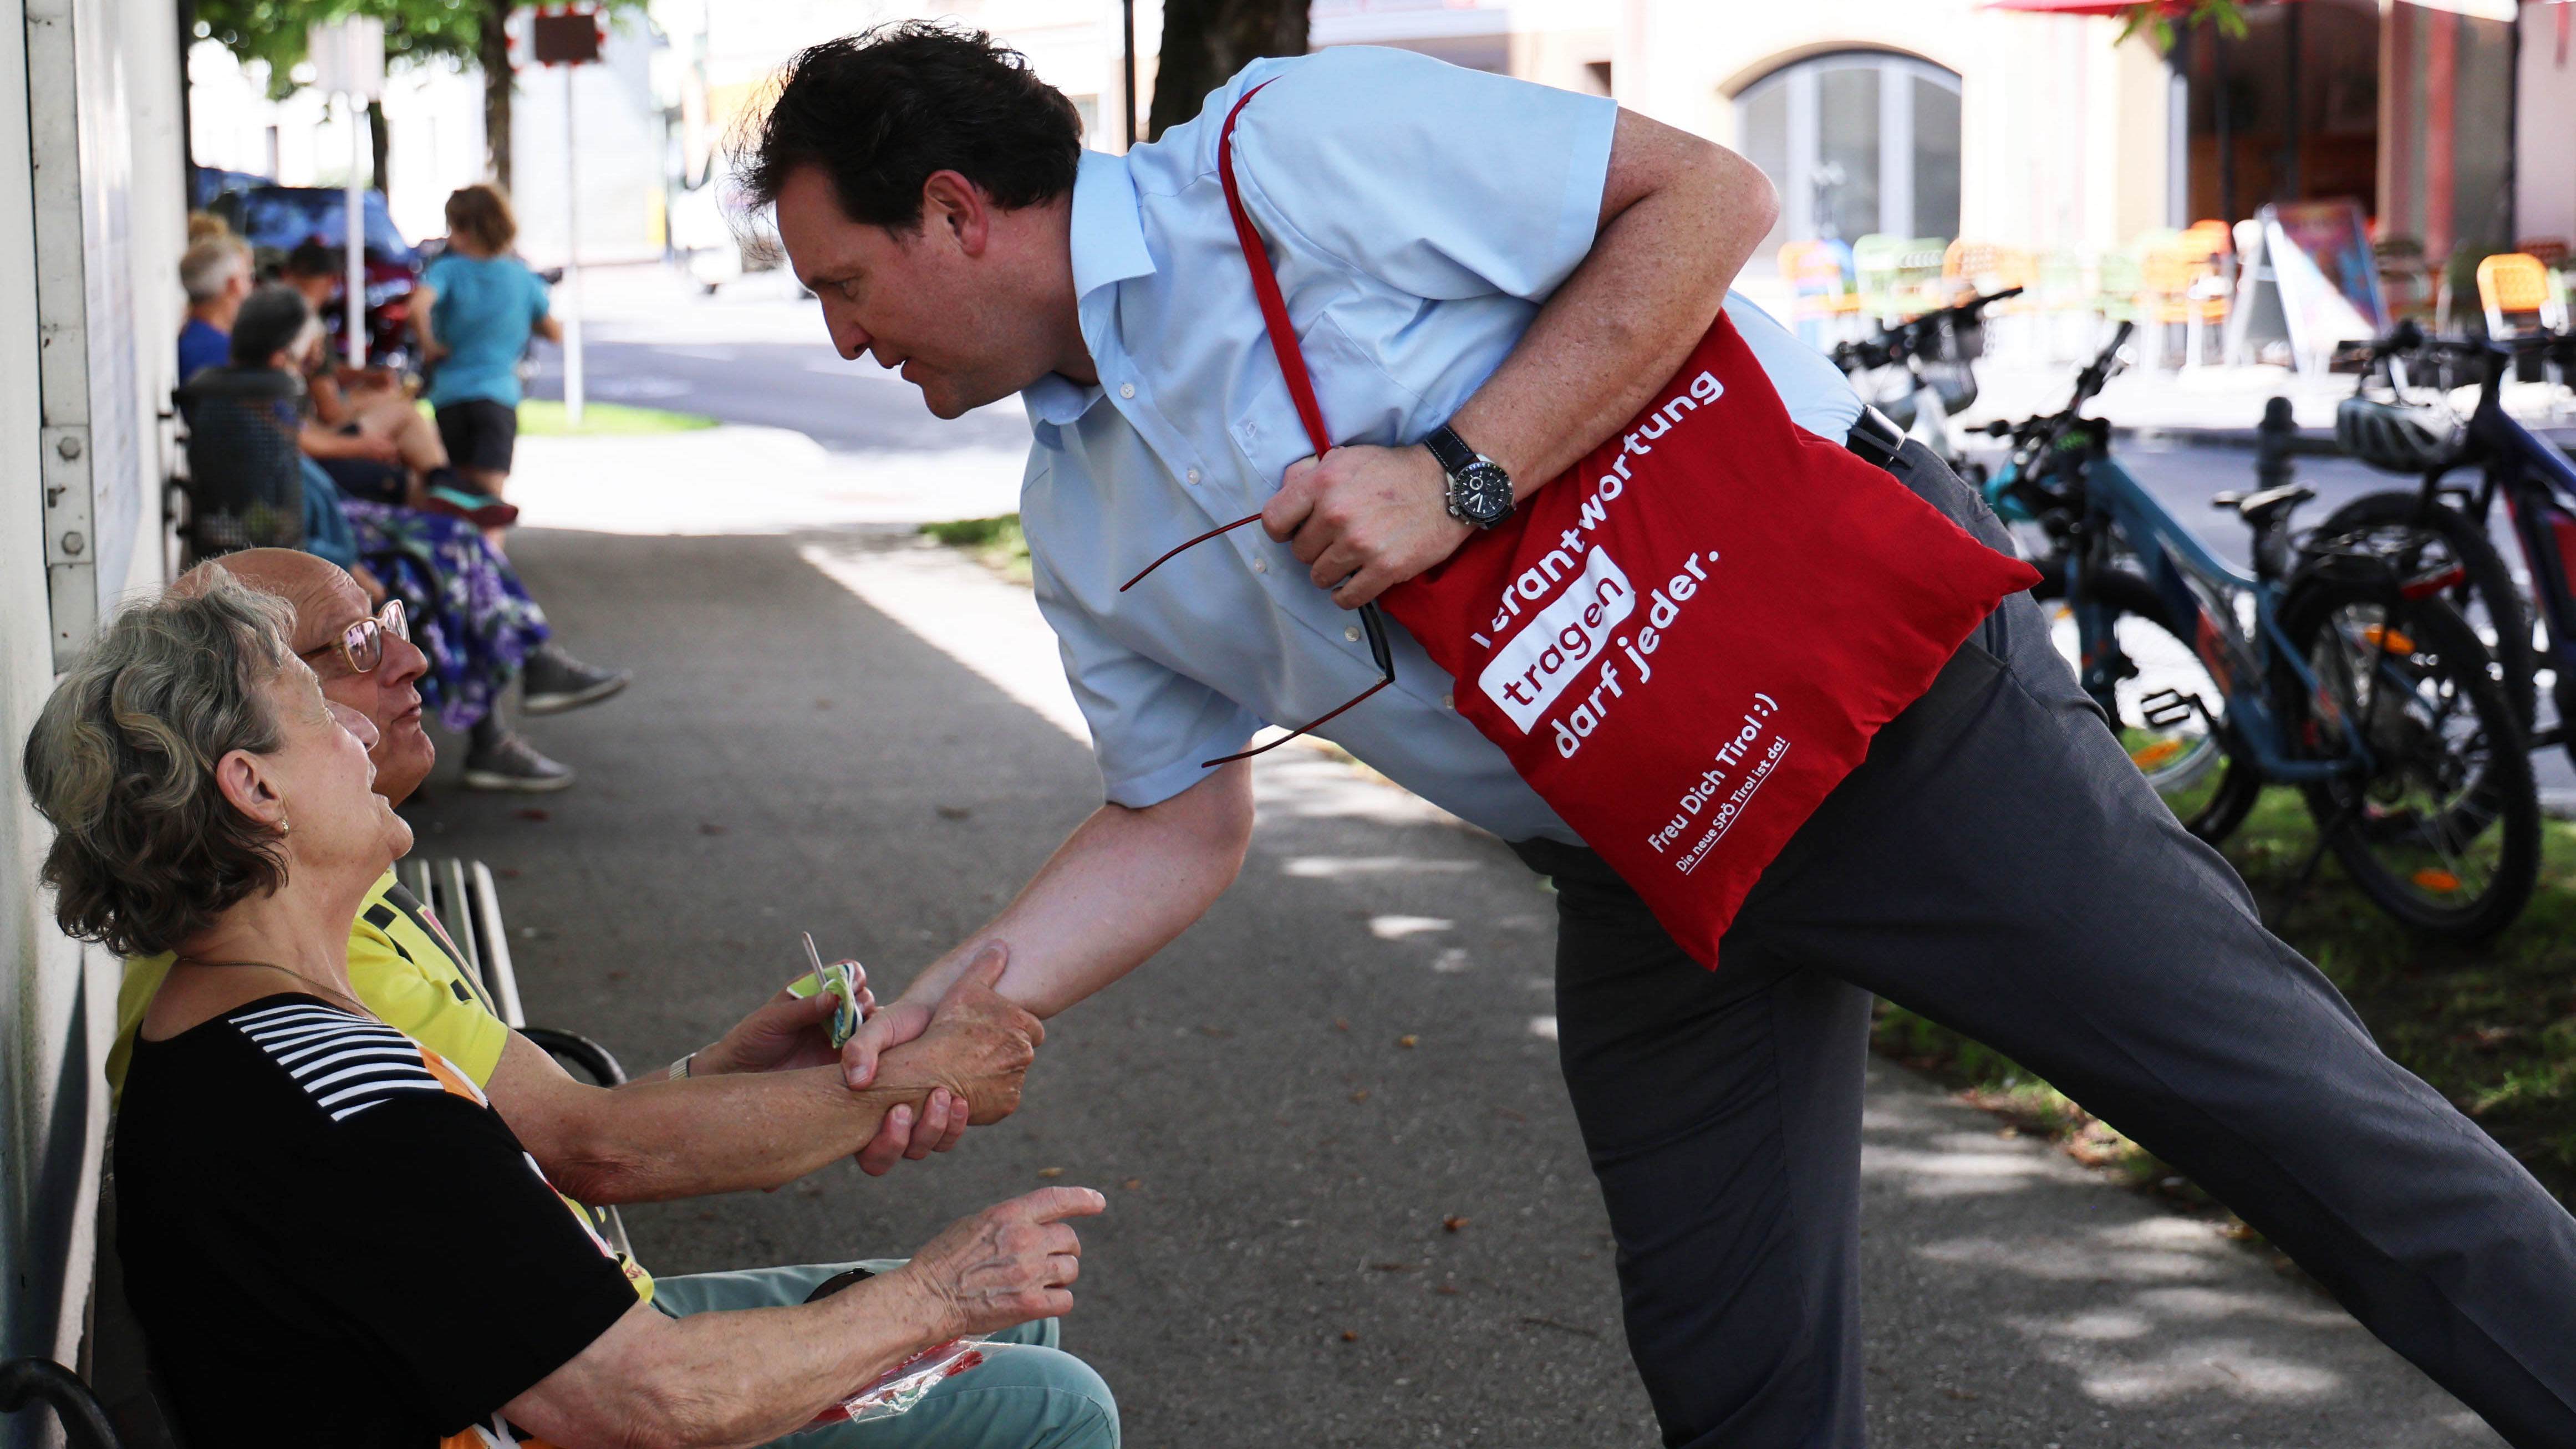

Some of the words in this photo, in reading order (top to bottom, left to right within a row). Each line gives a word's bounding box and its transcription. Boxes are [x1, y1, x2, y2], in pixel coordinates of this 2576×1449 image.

[1503, 577, 1623, 706] tragen
[1551, 659, 1623, 759] darf
[1617, 550, 1719, 684] jeder.
[1647, 813, 1689, 853] Freu
[1679, 769, 1726, 815] Dich
[1715, 714, 1763, 766] Tirol
[1676, 854, 1695, 872] Die
[1692, 829, 1717, 855] neue
[1712, 803, 1735, 830] SPÖ
[1730, 775, 1757, 803] Tirol
[1751, 759, 1771, 777] ist
[1767, 735, 1786, 759] da!
